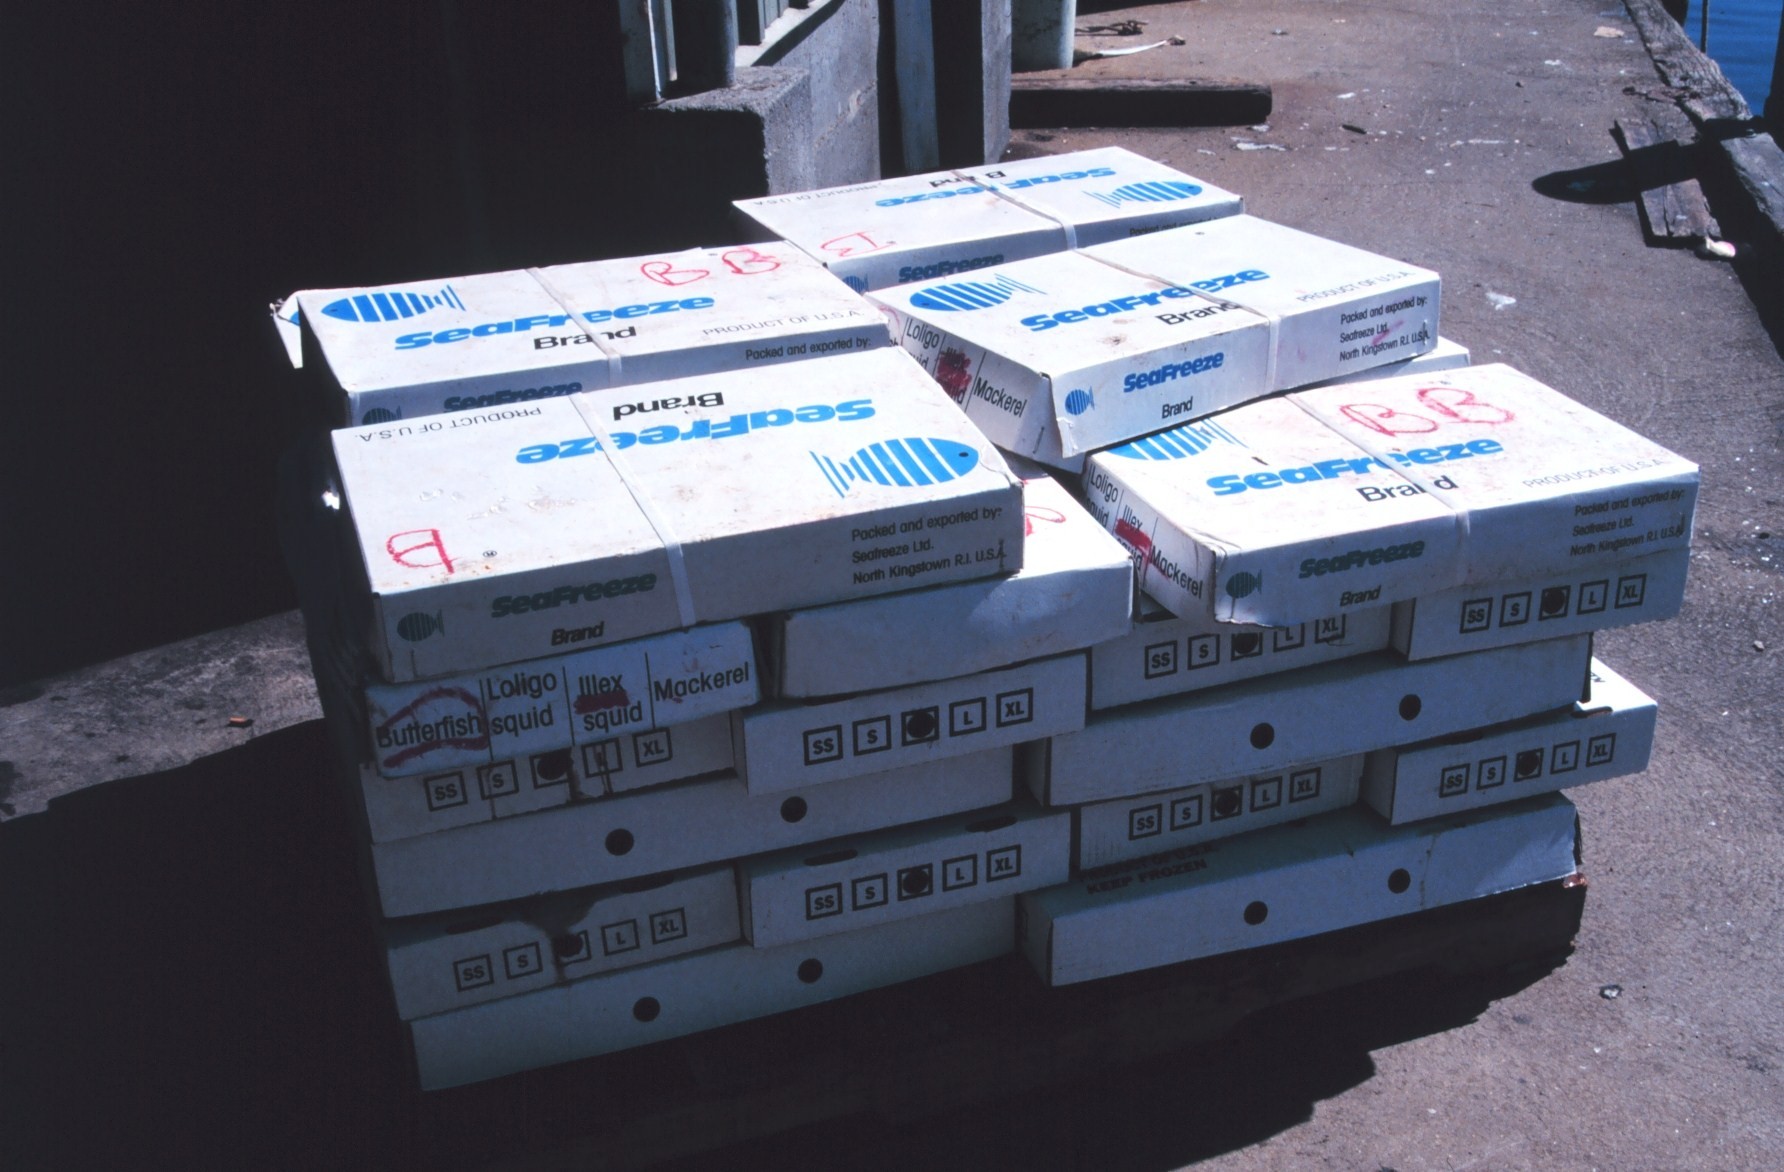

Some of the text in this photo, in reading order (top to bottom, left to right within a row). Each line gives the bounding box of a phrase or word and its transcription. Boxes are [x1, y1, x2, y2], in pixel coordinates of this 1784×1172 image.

[394, 297, 715, 350] SeaFreeze
[703, 319, 784, 336] PRODUCT
[788, 314, 809, 325] OF
[1340, 295, 1428, 326] Packed and exported by:
[534, 326, 638, 351] Brand
[745, 344, 784, 361] Packed
[786, 342, 807, 355] and
[809, 336, 853, 355] exported
[856, 335, 872, 351] by:
[906, 317, 940, 351] Loligo
[1339, 328, 1375, 344] Seafreeze
[1339, 346, 1360, 362] North
[1361, 338, 1399, 358] Kingstown
[1123, 351, 1225, 393] SeaFreeze
[613, 391, 725, 421] Brand
[973, 376, 1028, 418] Mackerel
[1161, 395, 1193, 420] Brand
[354, 406, 543, 442] PRODUCT OF U.S.A.
[1089, 463, 1119, 503] Loligo
[1121, 504, 1144, 534] Illex
[1574, 499, 1609, 517] Packed
[1611, 497, 1629, 510] and
[1631, 490, 1669, 509] exported
[852, 520, 897, 543] Packed
[899, 516, 923, 534] and
[926, 510, 979, 531] exported
[982, 507, 1004, 522] by:
[851, 537, 935, 564] Seafreeze Ltd.
[1299, 540, 1426, 579] SeaFreeze
[1569, 543, 1596, 557] North
[1597, 533, 1645, 555] Kingstown
[853, 568, 886, 586] North
[888, 558, 951, 580] Kingstown
[953, 551, 973, 567] R.I.
[1150, 545, 1204, 599] Mackerel
[491, 573, 658, 618] SeaFreeze
[1340, 585, 1382, 607] Brand
[1467, 608, 1485, 624] SS
[1510, 602, 1520, 617] S
[1622, 583, 1639, 600] XL
[551, 621, 605, 646] Brand
[1151, 652, 1171, 669] SS
[1198, 643, 1210, 660] S
[1321, 616, 1340, 634] XL
[486, 671, 558, 702] Loligo
[578, 673, 624, 698] Illex
[654, 661, 750, 701] Mackerel
[375, 710, 482, 749] Butterfish
[491, 703, 554, 736] squid
[583, 702, 643, 735] squid
[812, 700, 1026, 756] SS S L XL
[434, 739, 666, 801] SS S XL
[1445, 772, 1463, 790] SS
[1486, 765, 1497, 780] S
[1592, 743, 1609, 759] XL
[1136, 814, 1156, 832] SS
[1182, 806, 1192, 822] S
[1296, 778, 1314, 793] XL
[814, 856, 1014, 912] SS S L XL
[1137, 858, 1208, 883] FROZEN
[462, 918, 680, 983] SS S L XL
